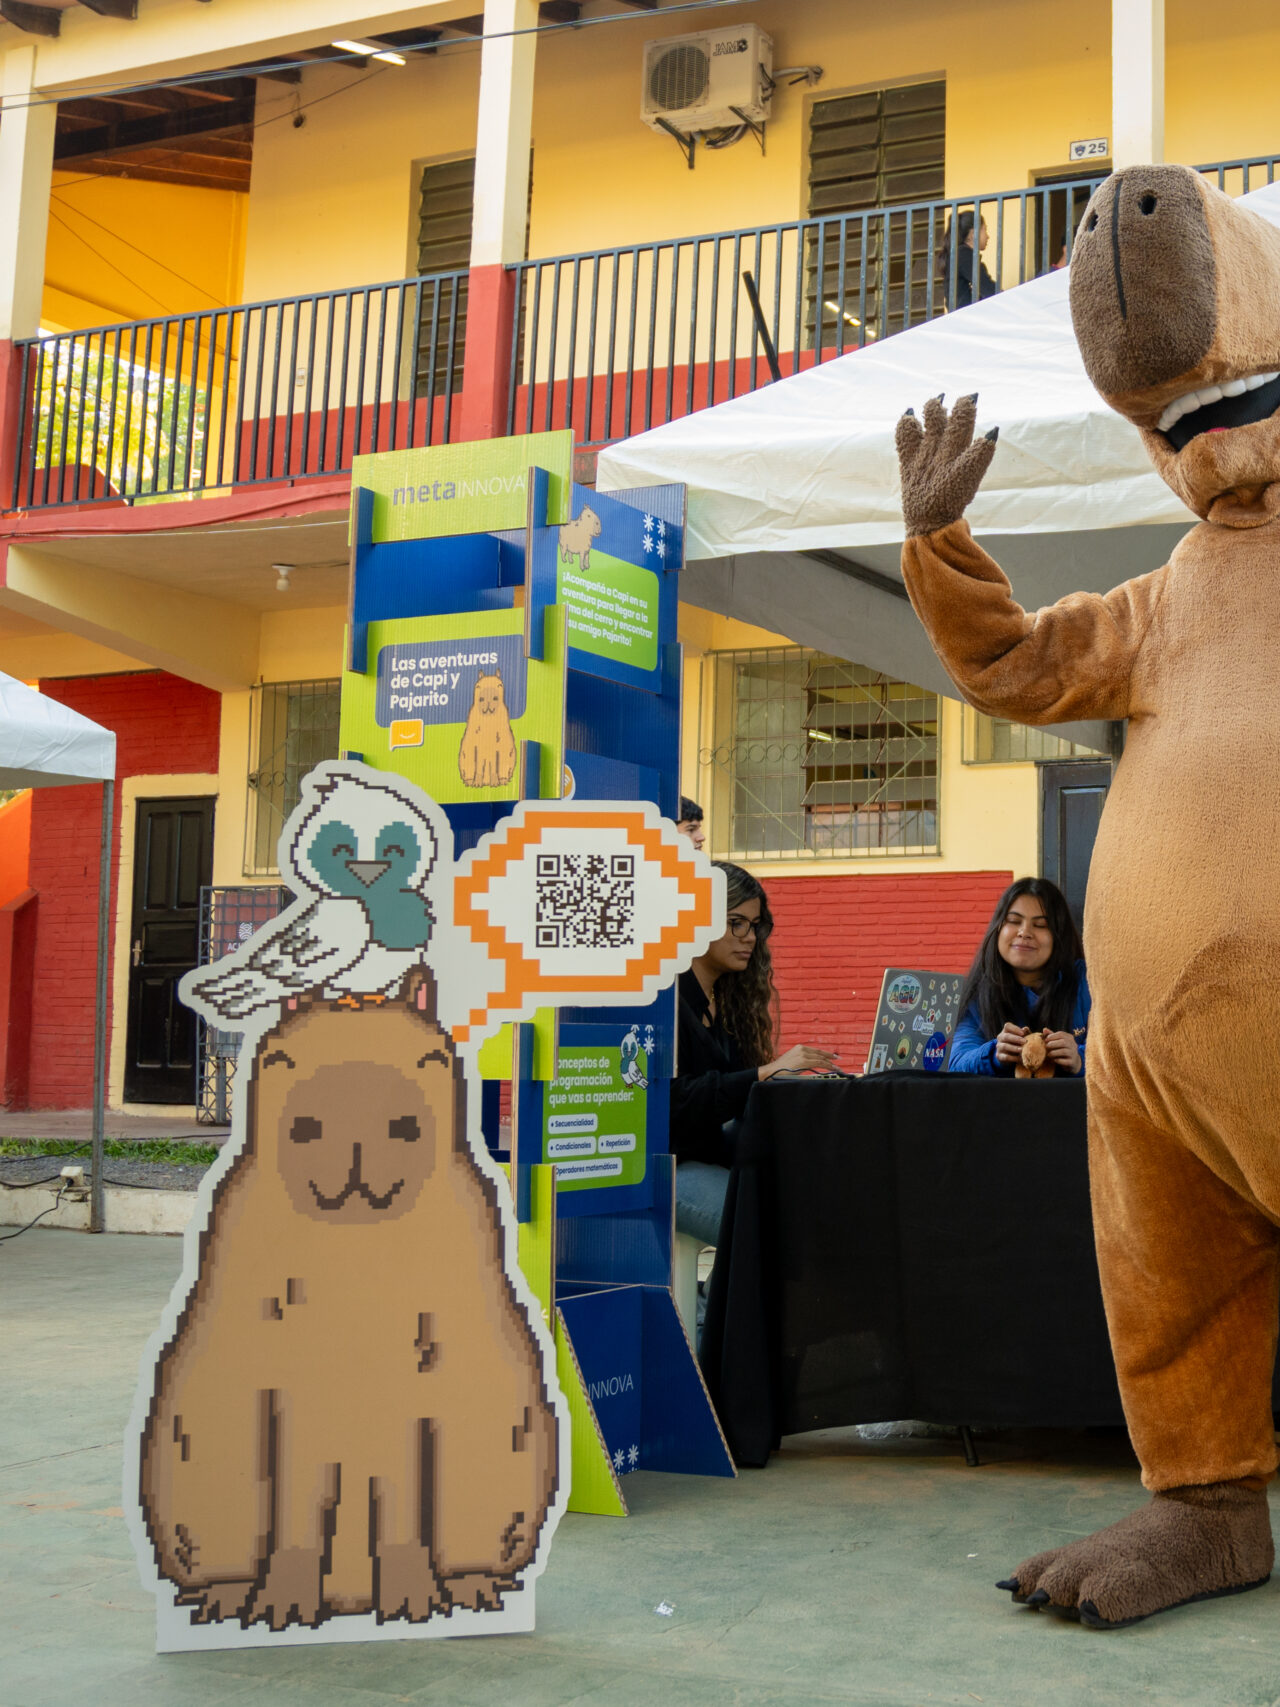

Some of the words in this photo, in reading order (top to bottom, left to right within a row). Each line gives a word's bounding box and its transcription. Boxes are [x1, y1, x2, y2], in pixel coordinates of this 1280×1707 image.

[1088, 142, 1106, 154] 25
[562, 572, 606, 594] ¡Acompañá
[606, 588, 612, 596] a
[612, 588, 629, 604] Capi
[629, 597, 639, 605] en
[639, 599, 648, 609] su
[562, 587, 597, 605] aventura
[597, 599, 614, 612] para
[615, 603, 635, 619] llegar
[641, 611, 649, 623] la
[582, 607, 594, 619] del
[594, 612, 613, 626] cerro
[613, 618, 619, 630] y
[619, 619, 653, 639] encontrar
[578, 622, 602, 638] amigo
[602, 628, 632, 646] Pajarito!
[391, 657, 417, 672] Las
[419, 652, 498, 670] aventuras
[390, 674, 410, 689] de
[412, 669, 448, 690] Capi
[450, 672, 460, 689] y
[390, 690, 449, 712] Pajarito
[925, 1048, 944, 1057] NASA
[558, 1056, 597, 1072] onceptos
[598, 1055, 611, 1068] de
[549, 1072, 613, 1090] programación
[549, 1093, 567, 1108] que
[568, 1093, 584, 1103] vas
[585, 1092, 592, 1102] a
[593, 1090, 634, 1106] aprender:
[555, 1119, 594, 1128] Secuencialidad
[555, 1142, 592, 1151] Condicionales
[605, 1138, 631, 1149] Repetición
